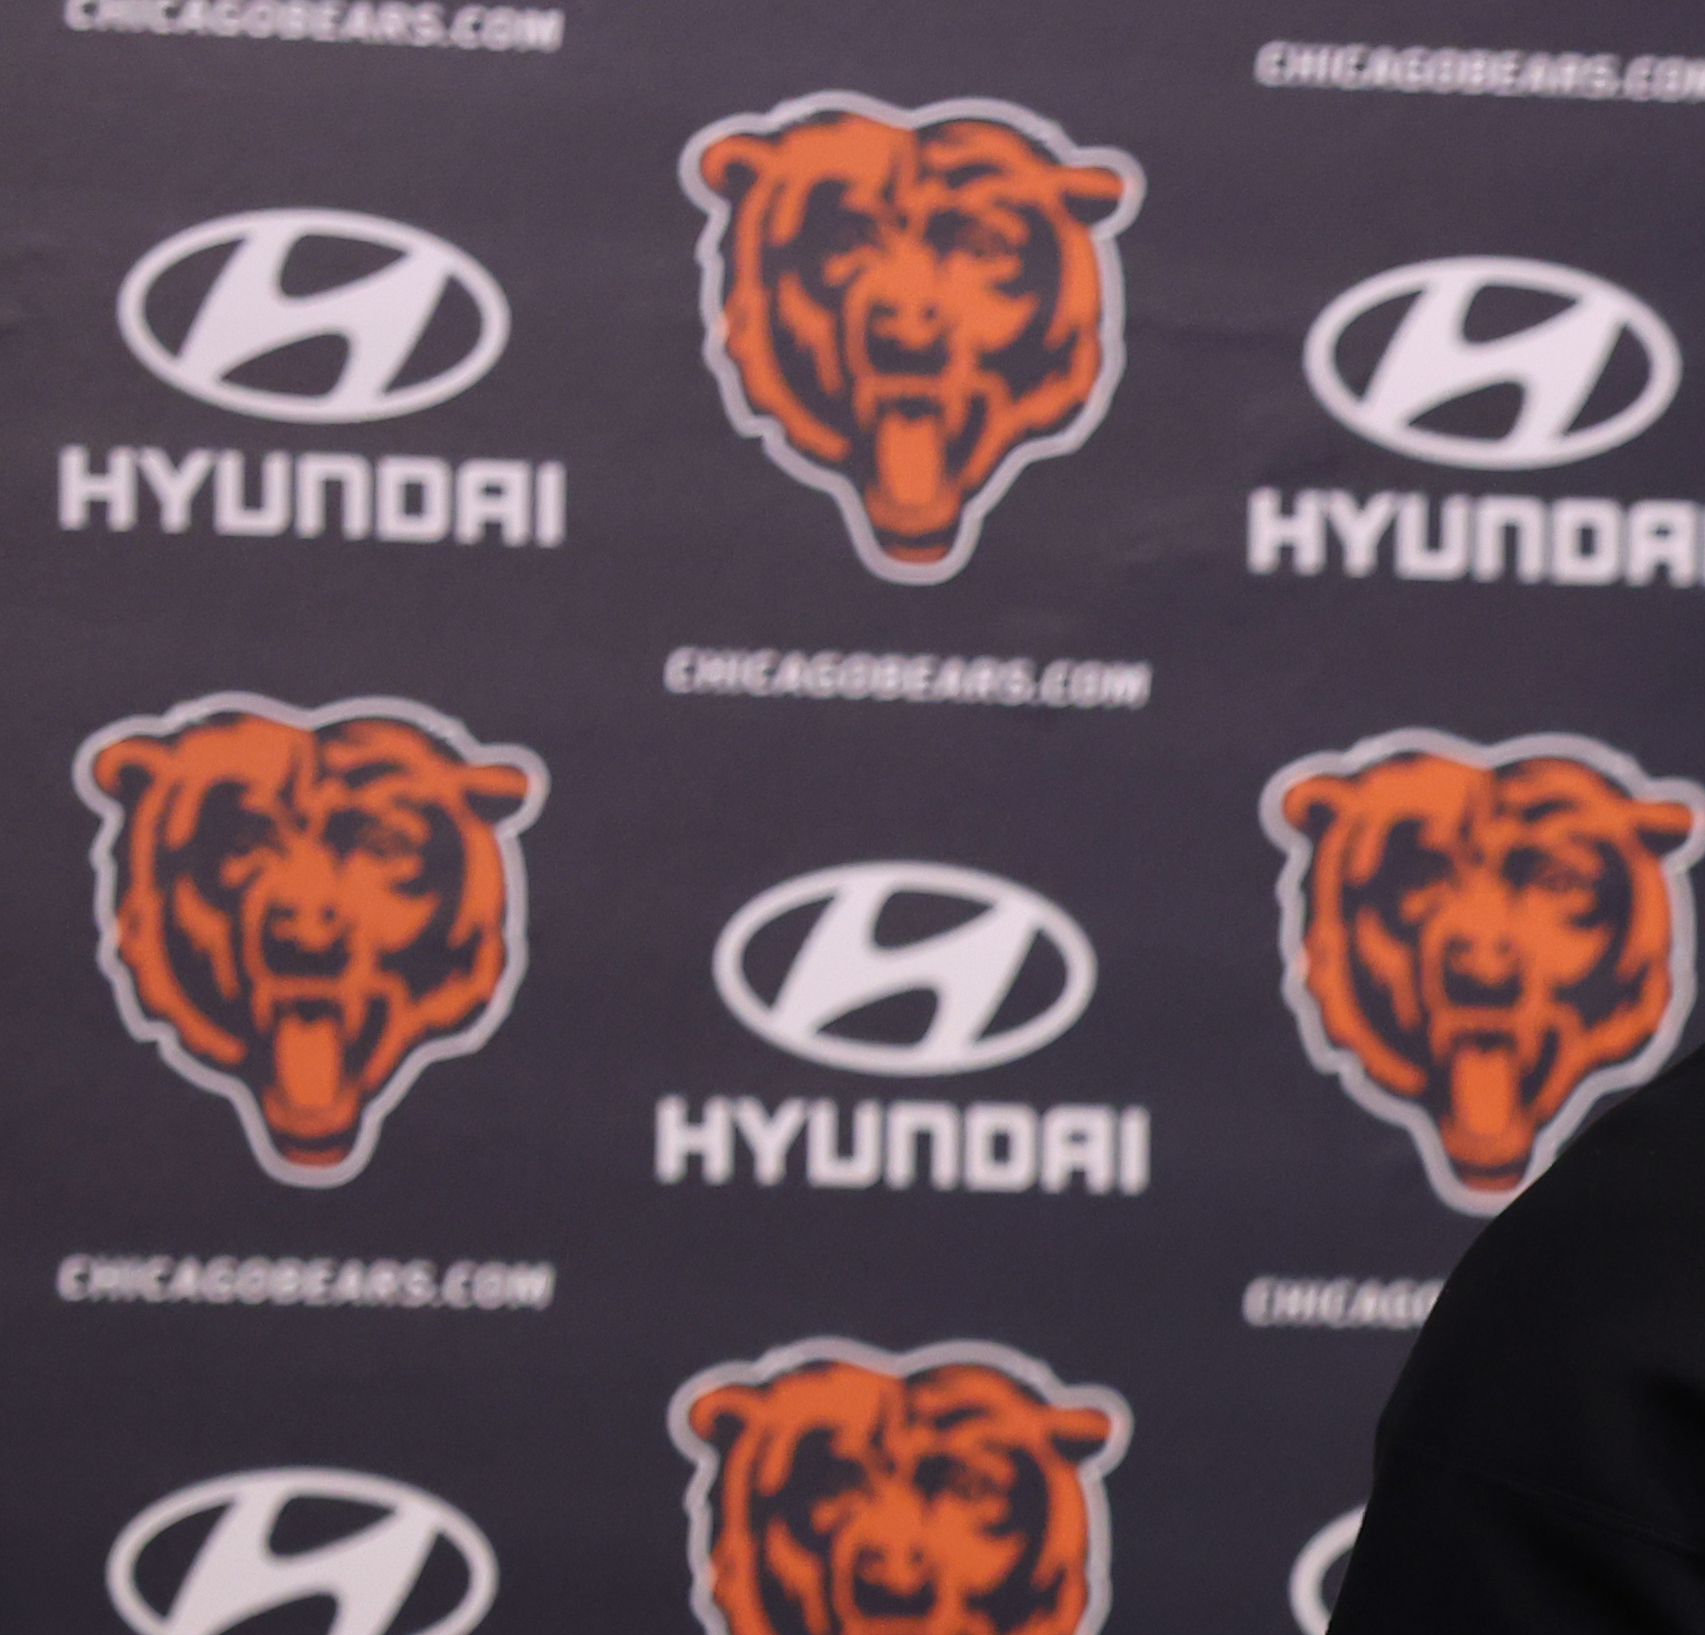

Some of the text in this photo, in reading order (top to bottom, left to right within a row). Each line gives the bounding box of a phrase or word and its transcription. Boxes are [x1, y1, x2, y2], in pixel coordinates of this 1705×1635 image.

[59, 445, 565, 547] HYUNDAI
[664, 647, 1151, 707] CHICAGOBEARS.COM
[656, 1096, 1149, 1194] HYUNDAI
[57, 1256, 555, 1309] CHICAGOBEARS.COM
